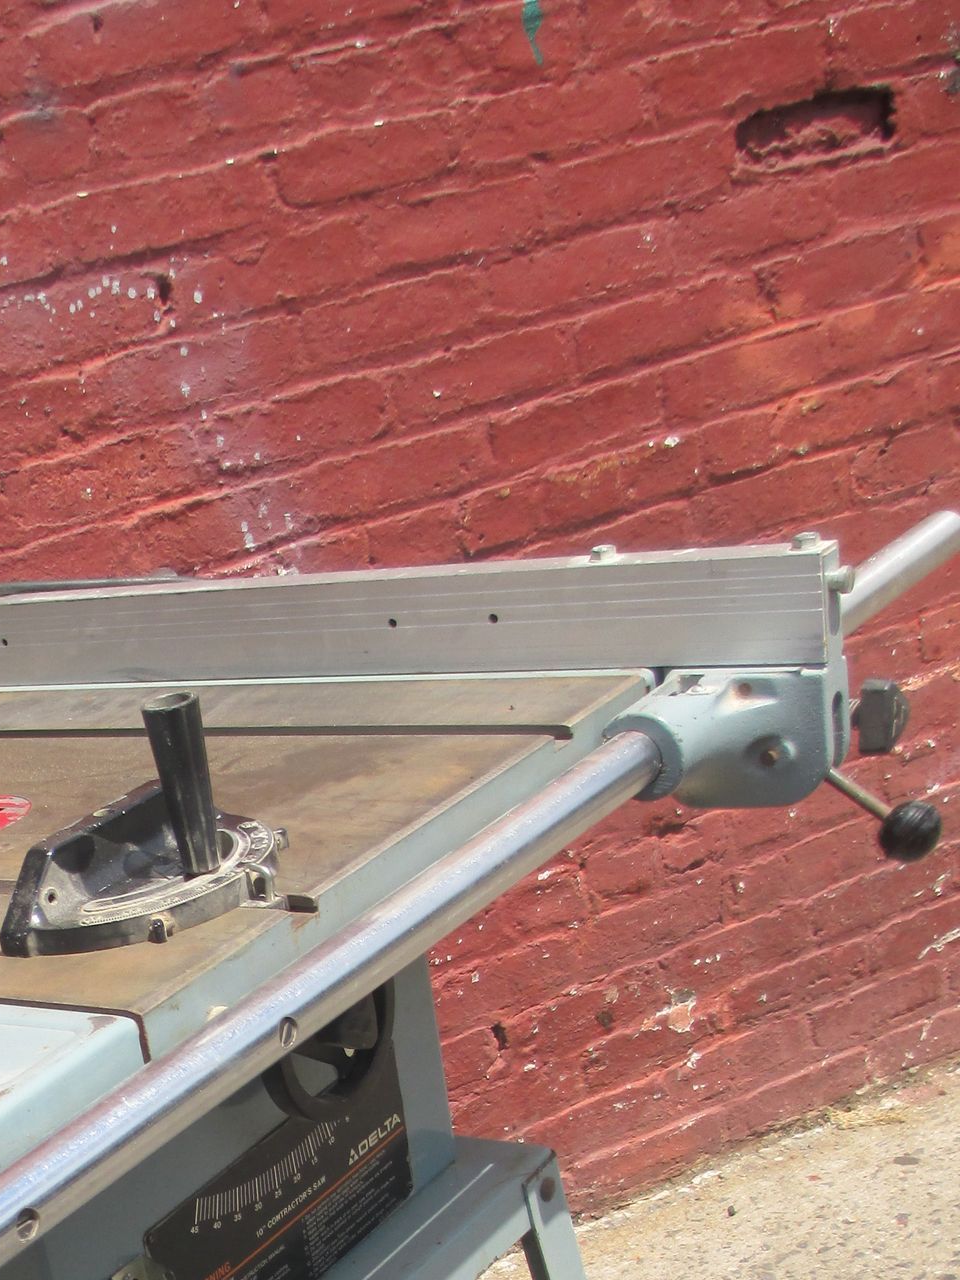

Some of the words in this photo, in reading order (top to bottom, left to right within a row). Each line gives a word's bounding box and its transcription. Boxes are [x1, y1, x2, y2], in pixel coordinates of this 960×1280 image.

[358, 1113, 401, 1157] DELTA
[328, 1136, 336, 1146] 10
[311, 1156, 319, 1166] 15
[293, 1173, 301, 1184] 20
[274, 1189, 282, 1199] 25
[254, 1202, 263, 1212] 30
[267, 1187, 313, 1229] CONTRACTOR'S
[312, 1175, 327, 1190] SAW
[233, 1213, 242, 1223] 35
[213, 1220, 222, 1229] 40
[190, 1226, 199, 1234] 45
